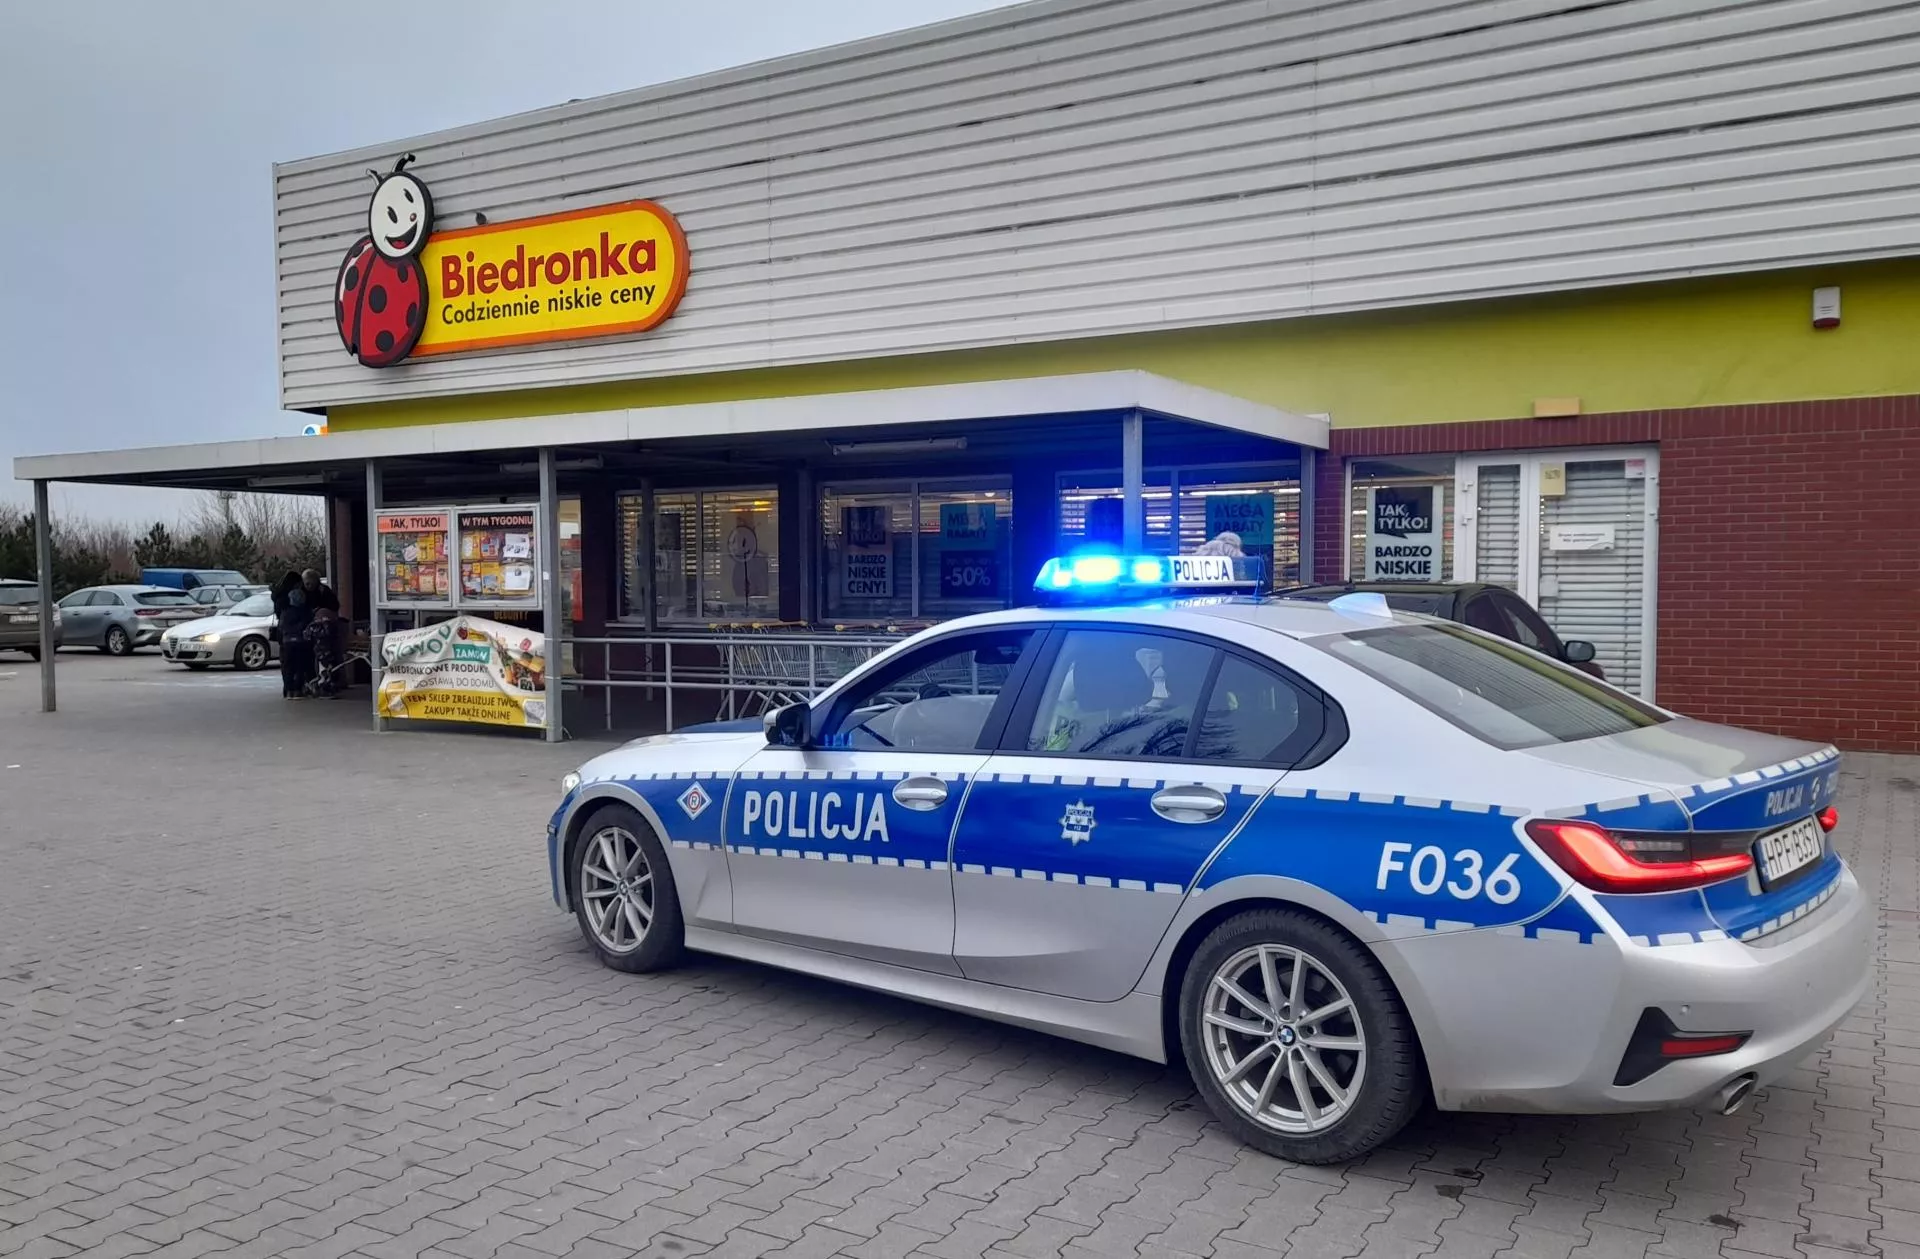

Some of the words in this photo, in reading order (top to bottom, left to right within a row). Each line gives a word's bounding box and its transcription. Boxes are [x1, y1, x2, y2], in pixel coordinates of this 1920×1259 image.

[441, 231, 656, 299] Biedronka
[442, 294, 540, 324] Codziennie
[548, 286, 602, 313] niskie
[610, 284, 656, 305] ceny
[1213, 502, 1264, 518] MEGA
[1378, 504, 1409, 517] TAK,
[389, 518, 408, 529] TAK,
[411, 517, 441, 528] TYLKO!
[462, 517, 471, 526] W
[472, 517, 489, 526] TYM
[490, 515, 533, 526] TYGODNIU
[1213, 520, 1264, 533] RABATY
[1378, 517, 1428, 530] TYLKO!
[1375, 545, 1432, 557] BARDZO
[848, 566, 886, 579] NISKIE
[1174, 560, 1230, 581] POLICJA
[1375, 560, 1432, 575] NISKIE
[945, 566, 991, 587] -50%
[848, 580, 886, 594] CENY!
[429, 693, 450, 702] SKLEP
[452, 693, 496, 706] ZREALIZUJE
[424, 705, 455, 716] ZAKUPY
[481, 709, 511, 721] ONLINE
[1764, 783, 1804, 818] POLICJA
[742, 790, 890, 843] POLICJA
[1764, 834, 1792, 877] HPF
[1792, 821, 1818, 864] B357
[1375, 840, 1522, 905] F036
